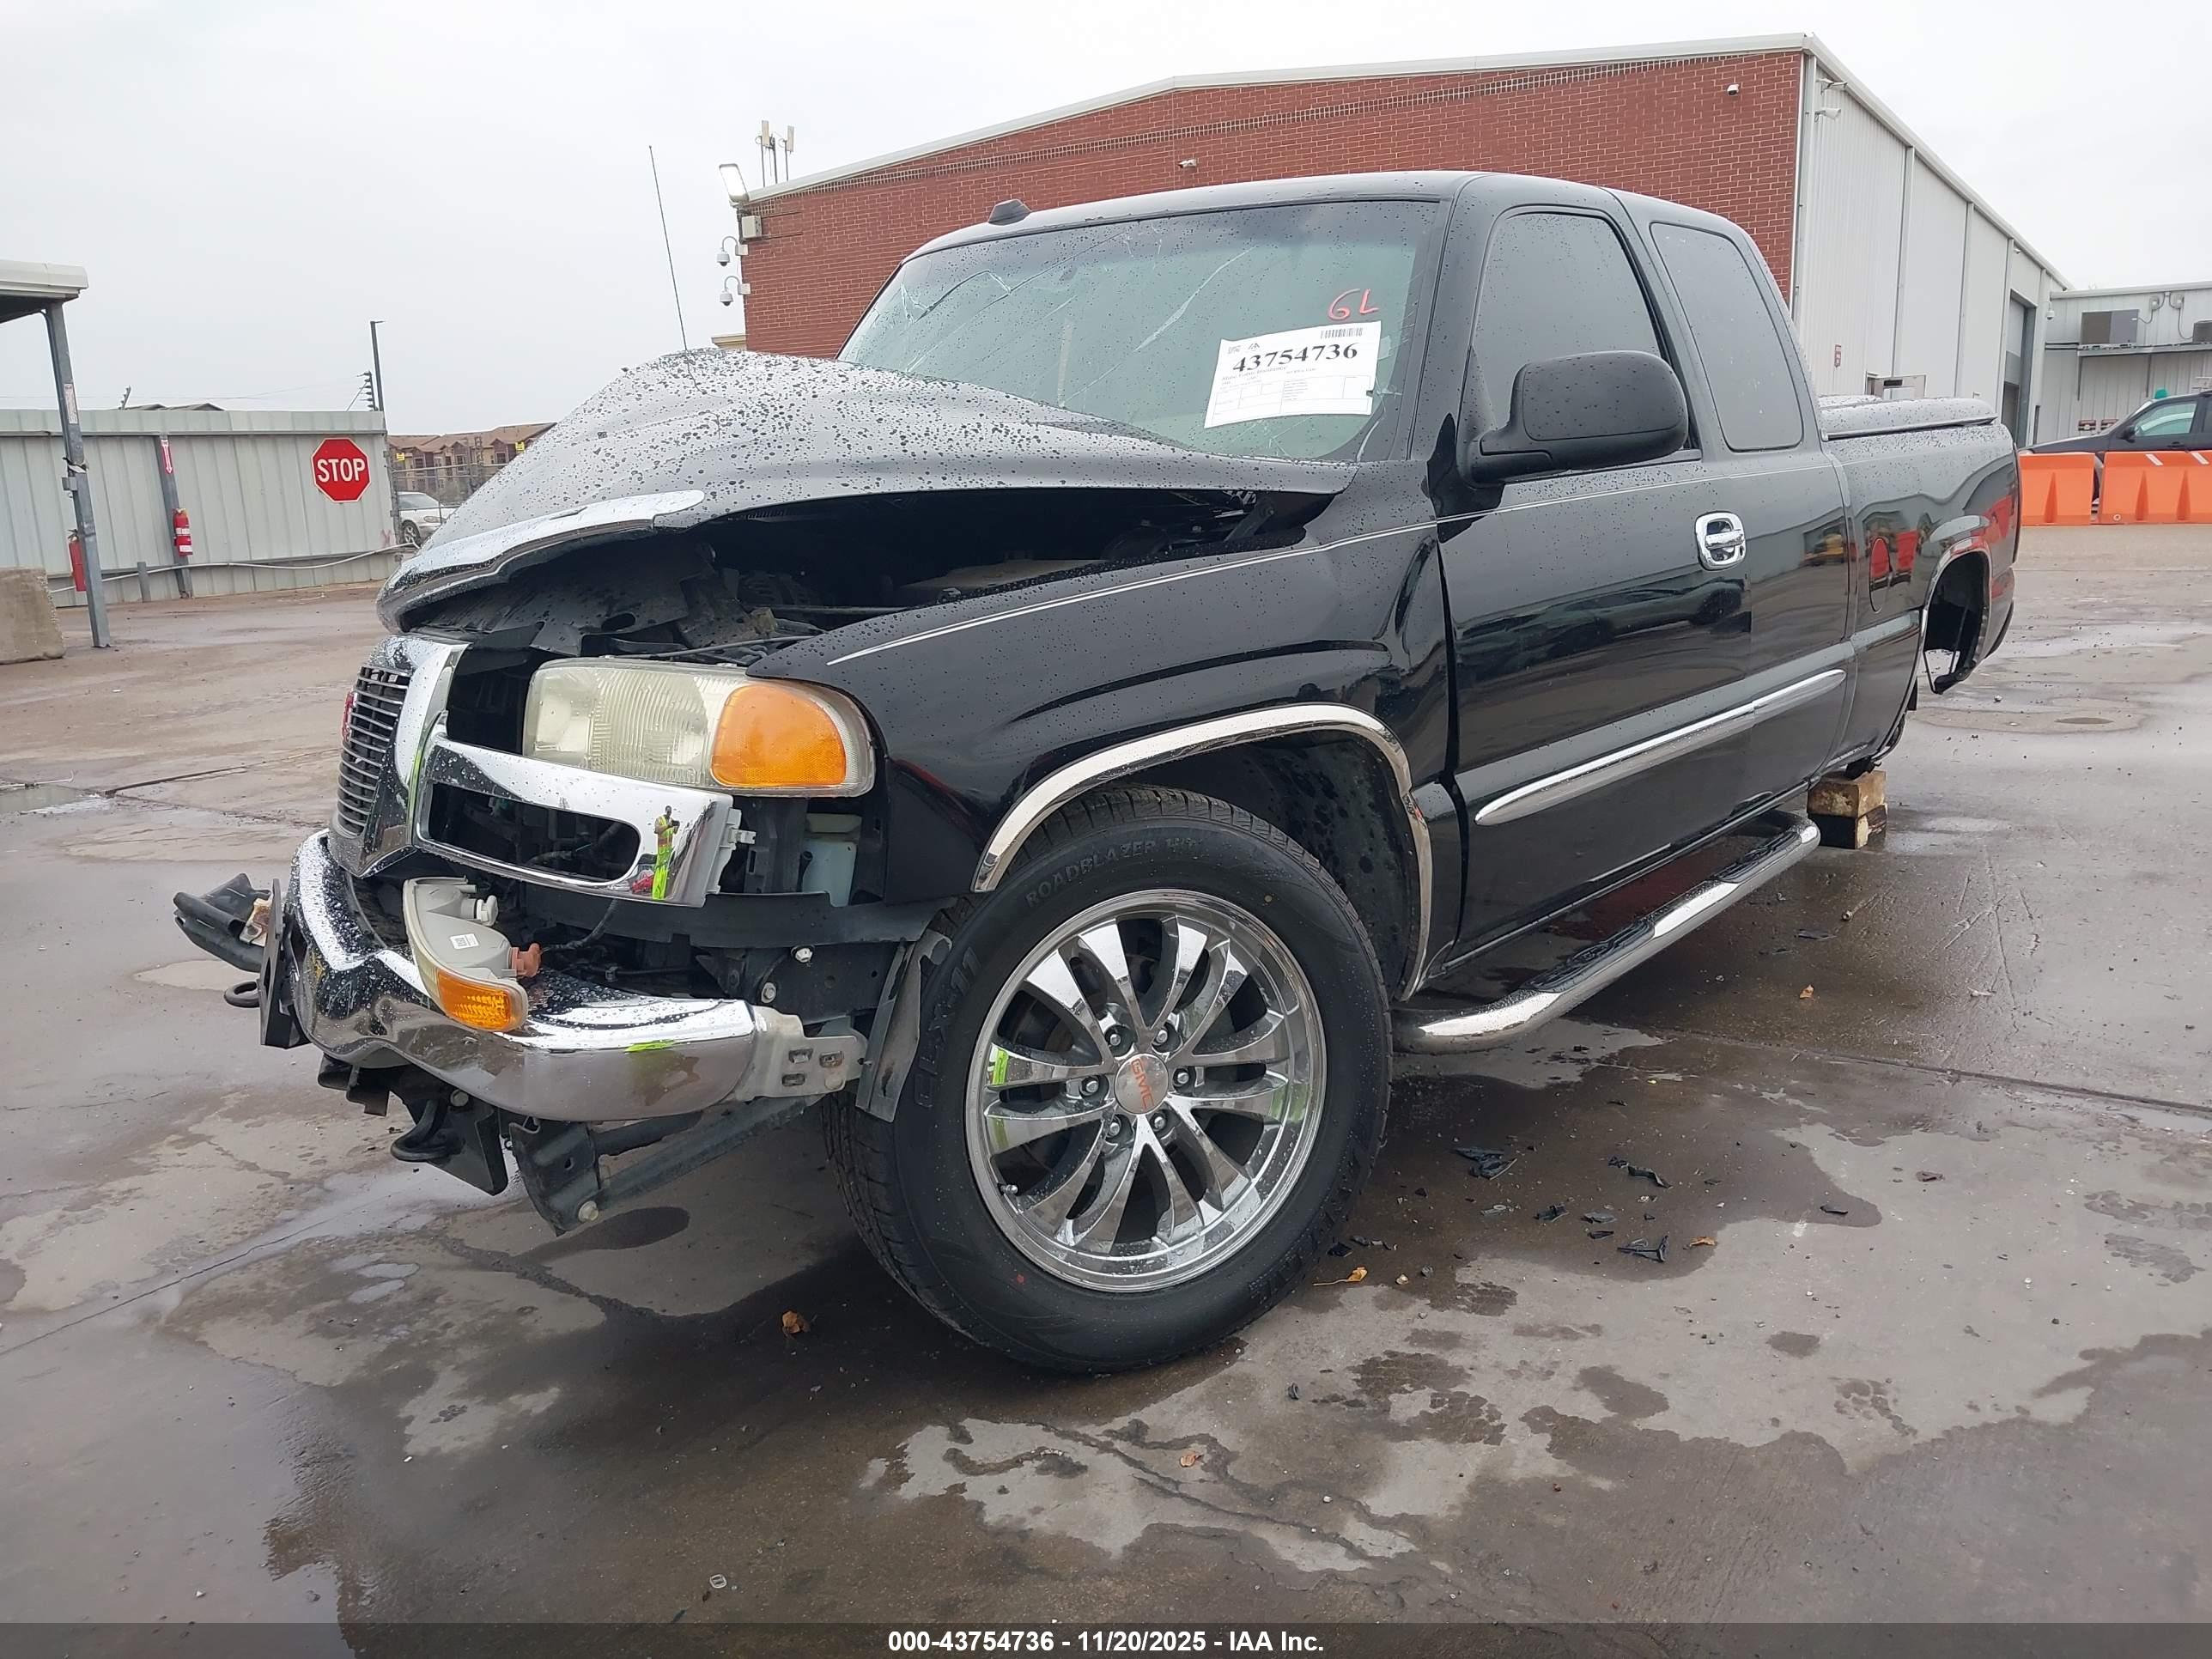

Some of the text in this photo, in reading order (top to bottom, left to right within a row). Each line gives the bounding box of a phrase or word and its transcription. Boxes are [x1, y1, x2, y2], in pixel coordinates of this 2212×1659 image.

[1232, 343, 1358, 372] 43754736
[317, 458, 365, 483] STOP
[1131, 1058, 1155, 1110] GMC
